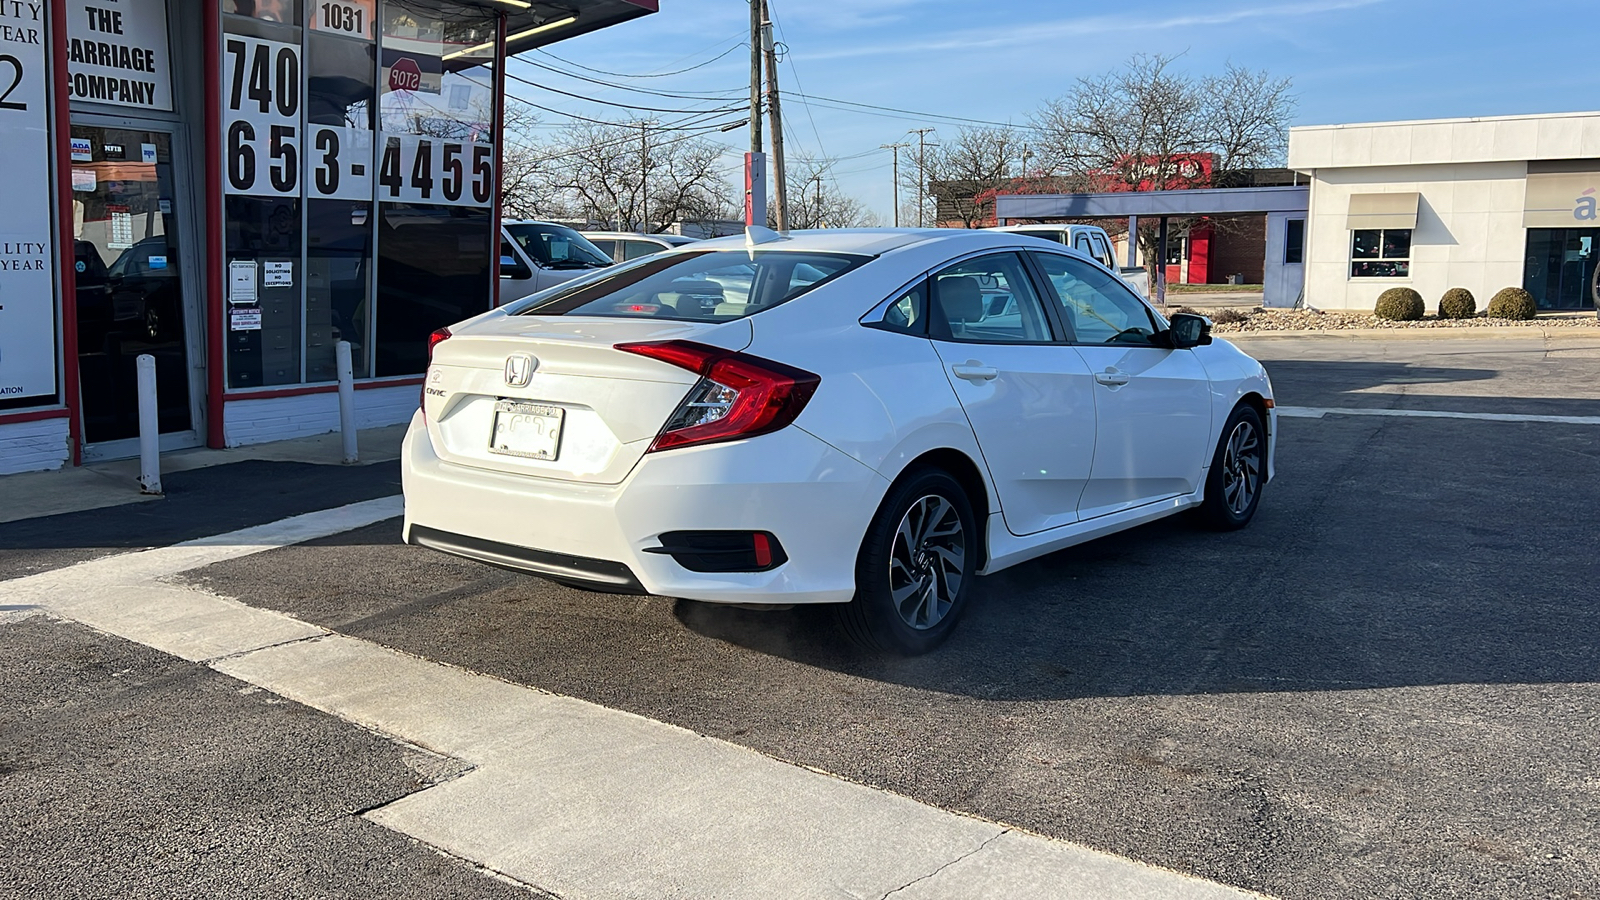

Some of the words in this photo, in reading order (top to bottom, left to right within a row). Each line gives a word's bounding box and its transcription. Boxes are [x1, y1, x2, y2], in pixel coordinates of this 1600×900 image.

[85, 6, 123, 35] THE
[321, 2, 362, 33] 1031
[0, 25, 40, 45] EAR
[227, 39, 298, 117] 740
[0, 243, 46, 254] LITY
[0, 259, 45, 271] YEAR
